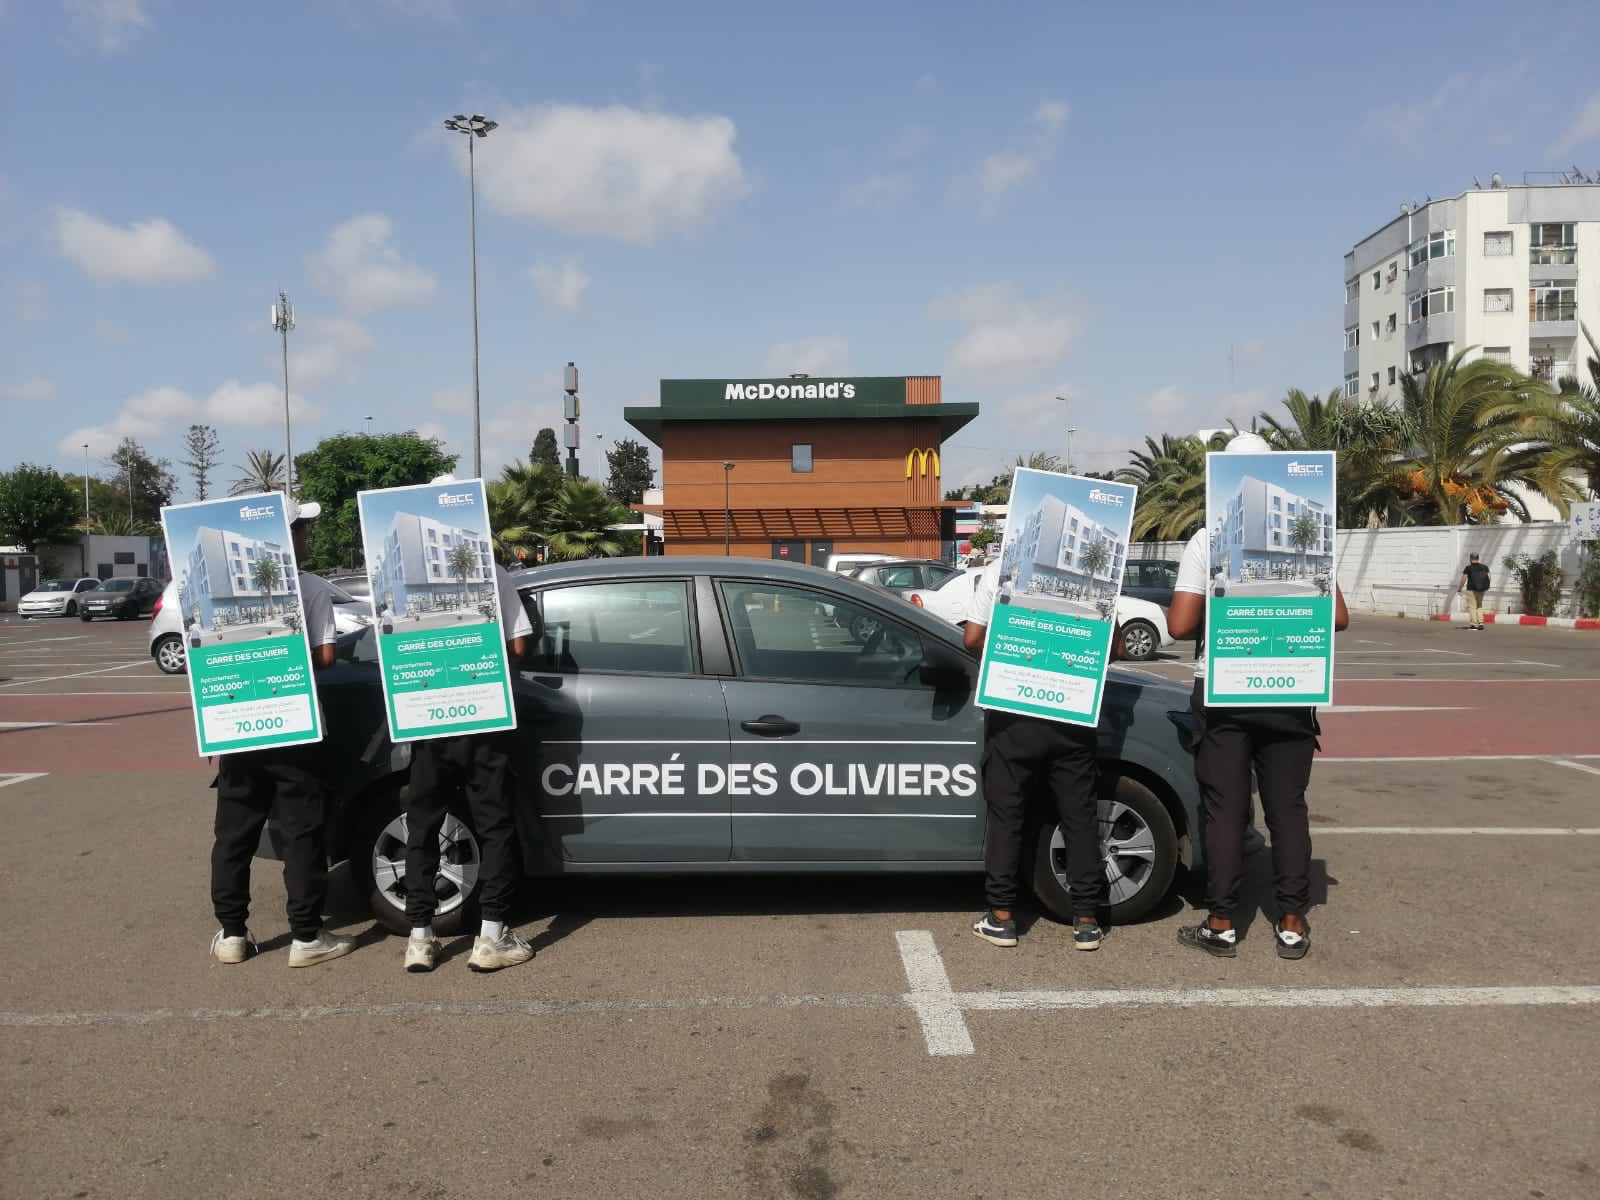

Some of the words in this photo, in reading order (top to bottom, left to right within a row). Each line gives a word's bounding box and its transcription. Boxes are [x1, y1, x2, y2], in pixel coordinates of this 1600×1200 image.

[725, 382, 856, 400] McDonald's
[1275, 608, 1313, 616] OLIVIERS
[1037, 623, 1054, 631] DES
[1055, 625, 1092, 637] OLIVIERS
[428, 640, 444, 648] DES
[445, 636, 483, 647] OLIVIERS
[235, 652, 251, 661] DES
[253, 648, 288, 658] OLIVIERS
[1246, 676, 1296, 688] 70.000
[1017, 685, 1065, 703] 70.000
[427, 704, 477, 720] 70.000
[235, 717, 283, 733] 70.000
[541, 753, 685, 796] CARRÉ
[697, 762, 778, 796] DES
[790, 762, 977, 797] OLIVIERS
